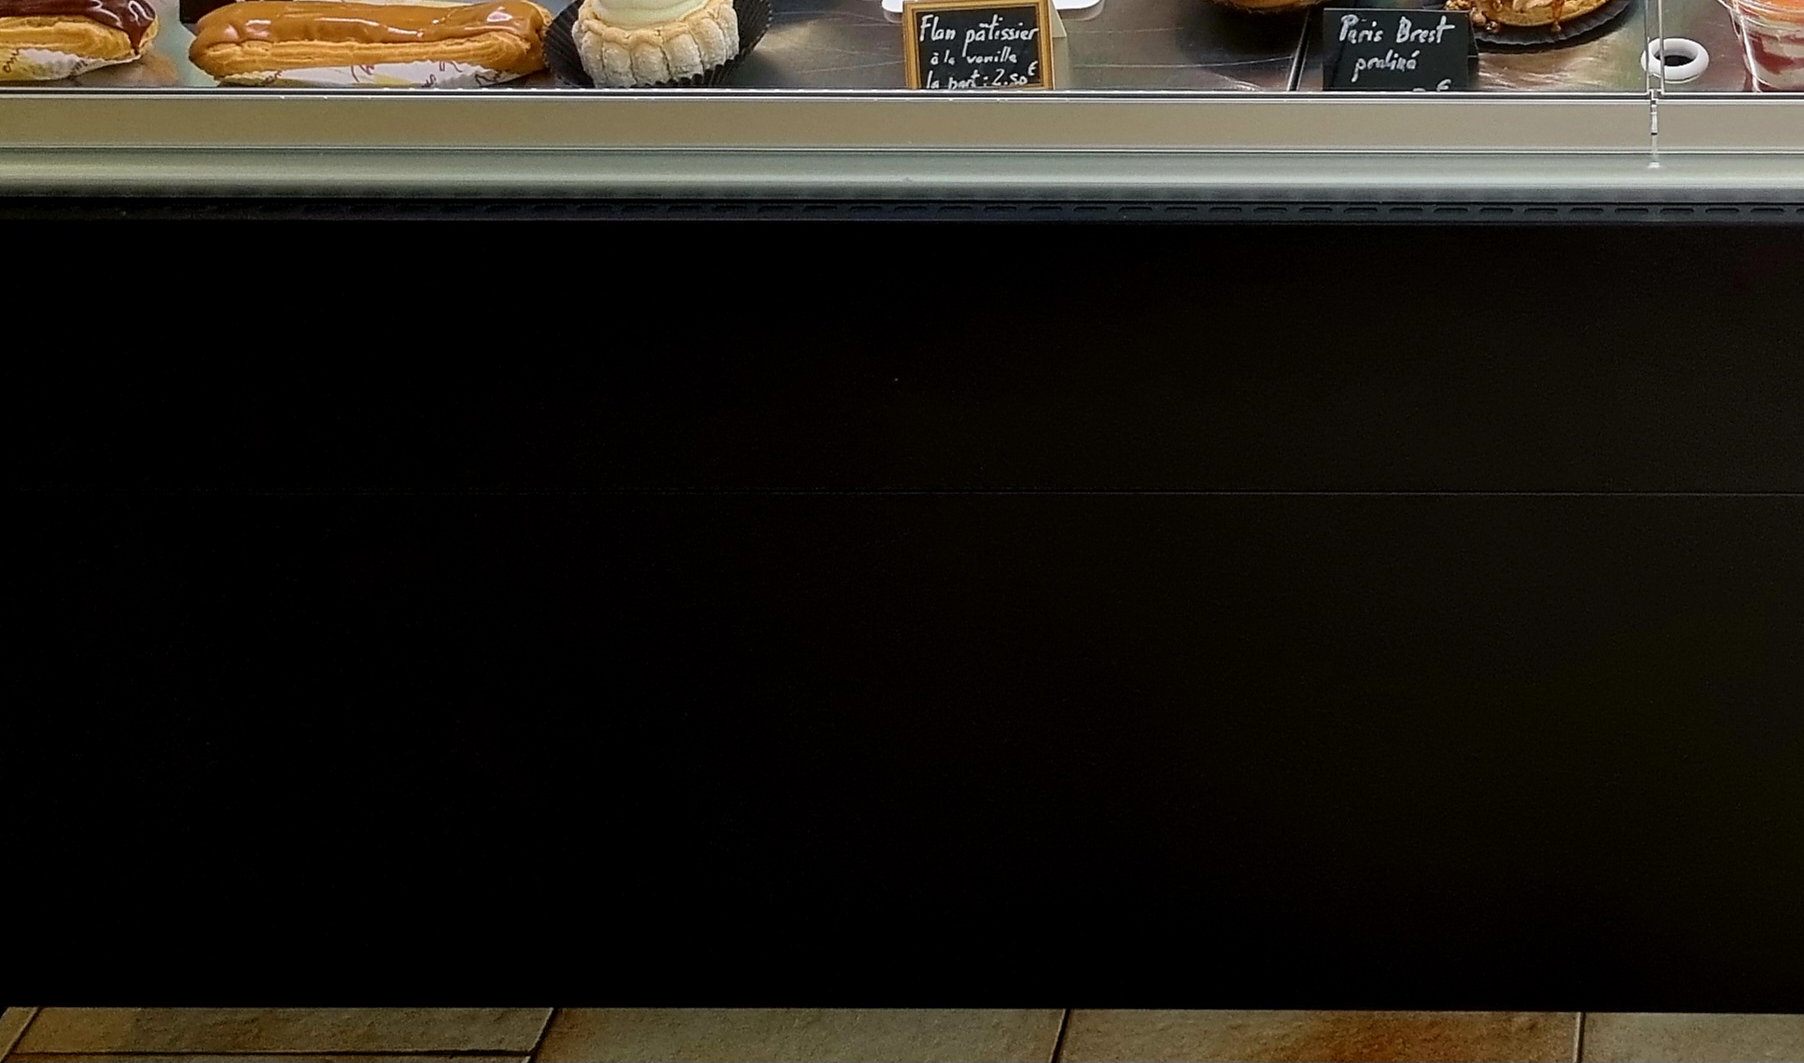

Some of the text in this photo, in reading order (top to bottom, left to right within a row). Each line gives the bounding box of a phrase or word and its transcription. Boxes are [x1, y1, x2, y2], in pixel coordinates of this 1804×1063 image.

[919, 13, 1039, 57] Flan pâtissier
[1338, 14, 1455, 44] Paris Brest
[930, 45, 1017, 65] à la vanille
[926, 70, 940, 89] la
